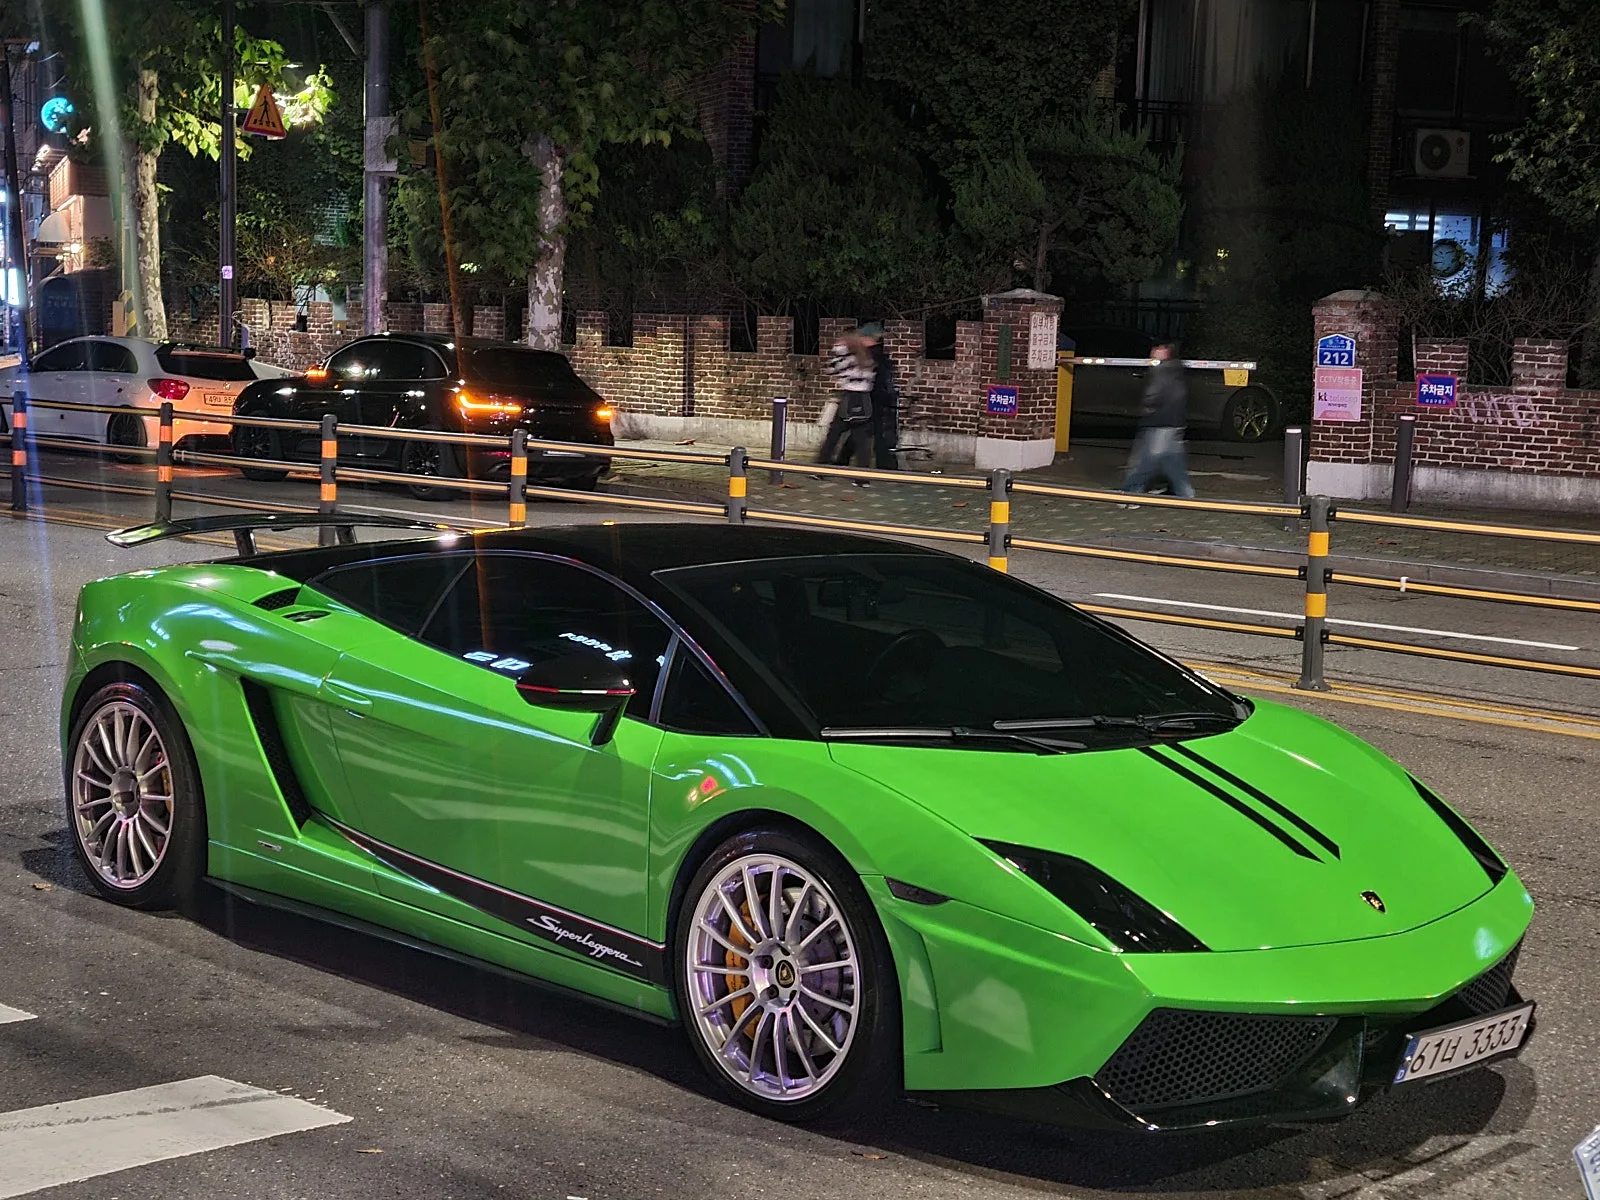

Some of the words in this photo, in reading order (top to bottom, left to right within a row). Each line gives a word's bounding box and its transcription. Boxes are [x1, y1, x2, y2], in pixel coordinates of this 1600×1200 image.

[1031, 349, 1053, 362] 주차금지
[1323, 351, 1349, 365] 212
[1420, 384, 1453, 396] 주차금지
[989, 394, 1016, 406] 주차금지
[526, 915, 643, 967] Superleggera
[1410, 1036, 1462, 1073] 61너
[1464, 1015, 1522, 1059] 3333
